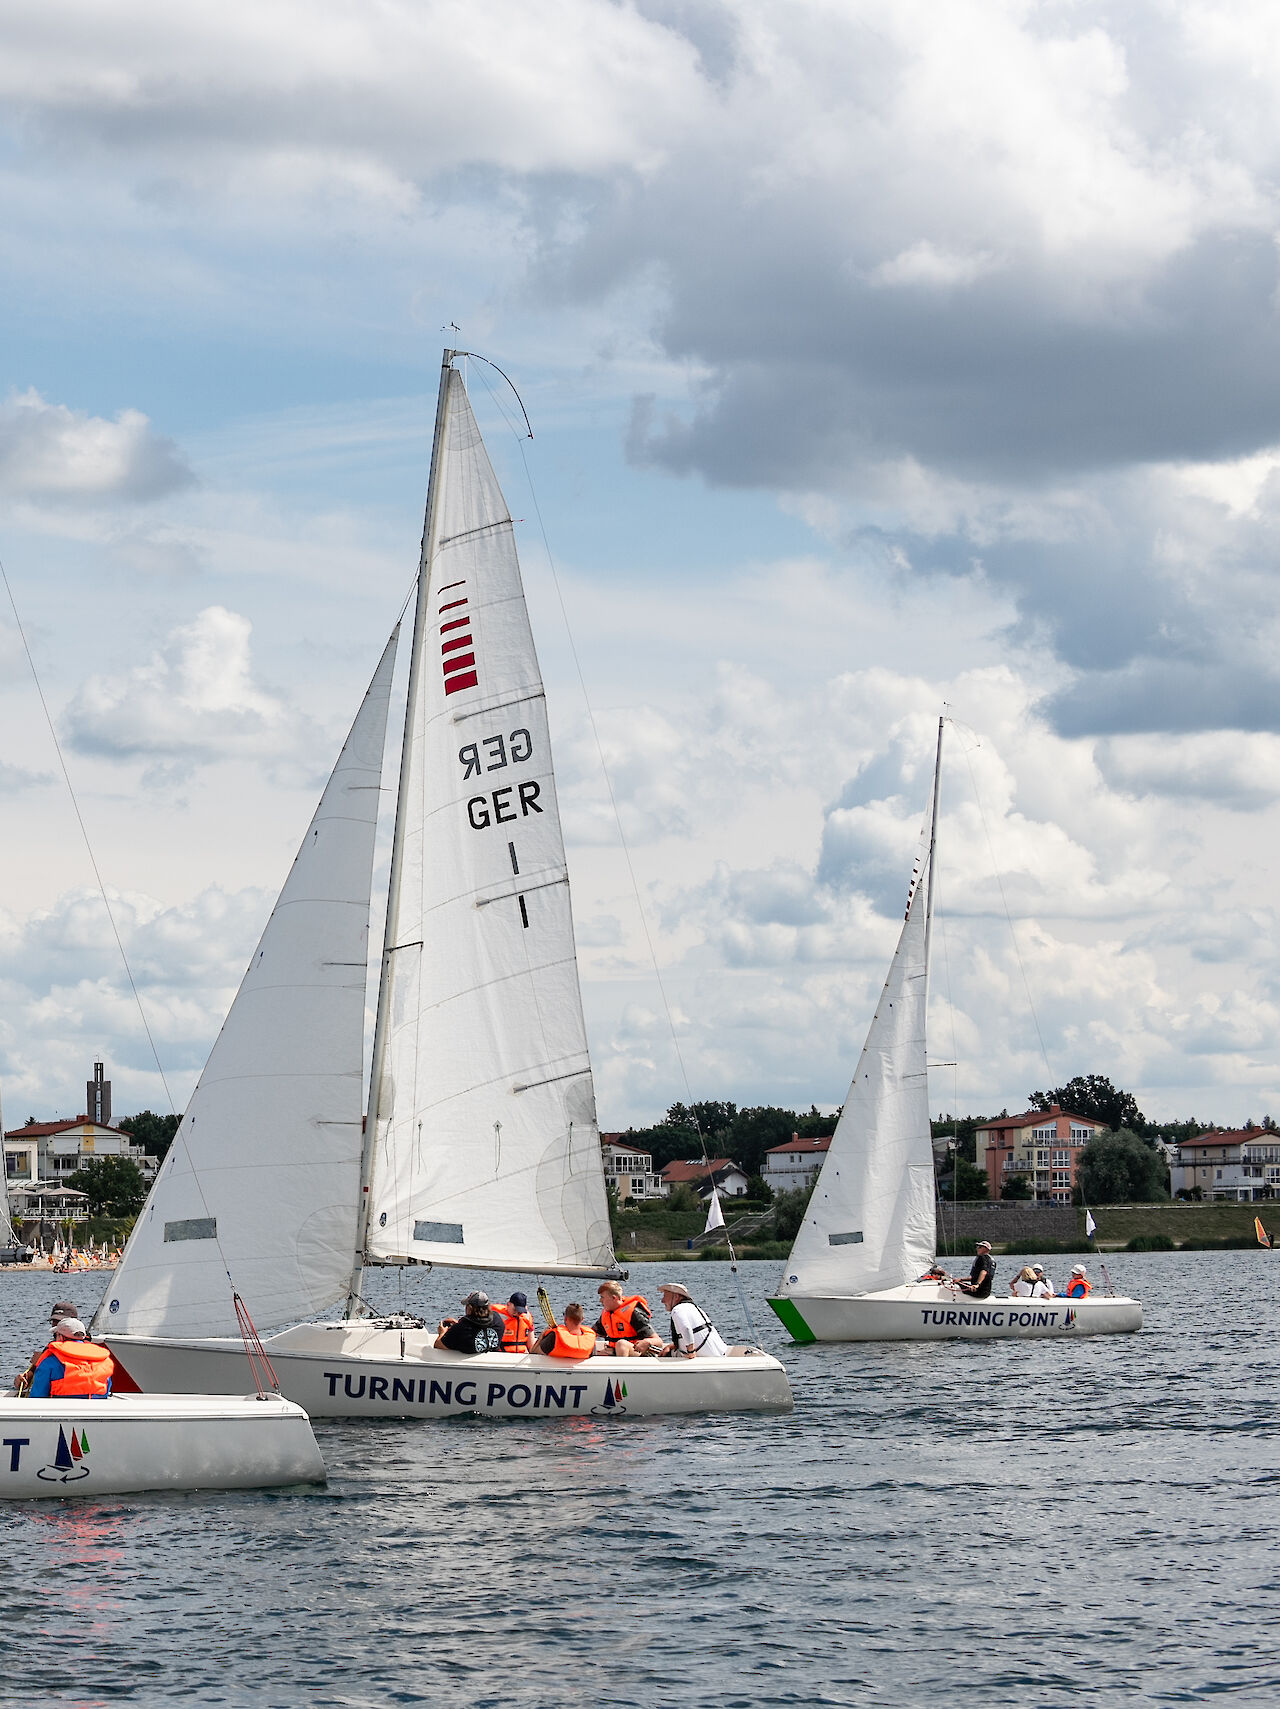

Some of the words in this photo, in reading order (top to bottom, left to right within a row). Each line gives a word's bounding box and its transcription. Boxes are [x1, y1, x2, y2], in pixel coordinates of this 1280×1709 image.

[467, 780, 544, 830] GER
[920, 1309, 1005, 1326] TURNING
[1007, 1312, 1059, 1327] POINT
[323, 1372, 477, 1406] TURNING
[487, 1383, 588, 1409] POINT
